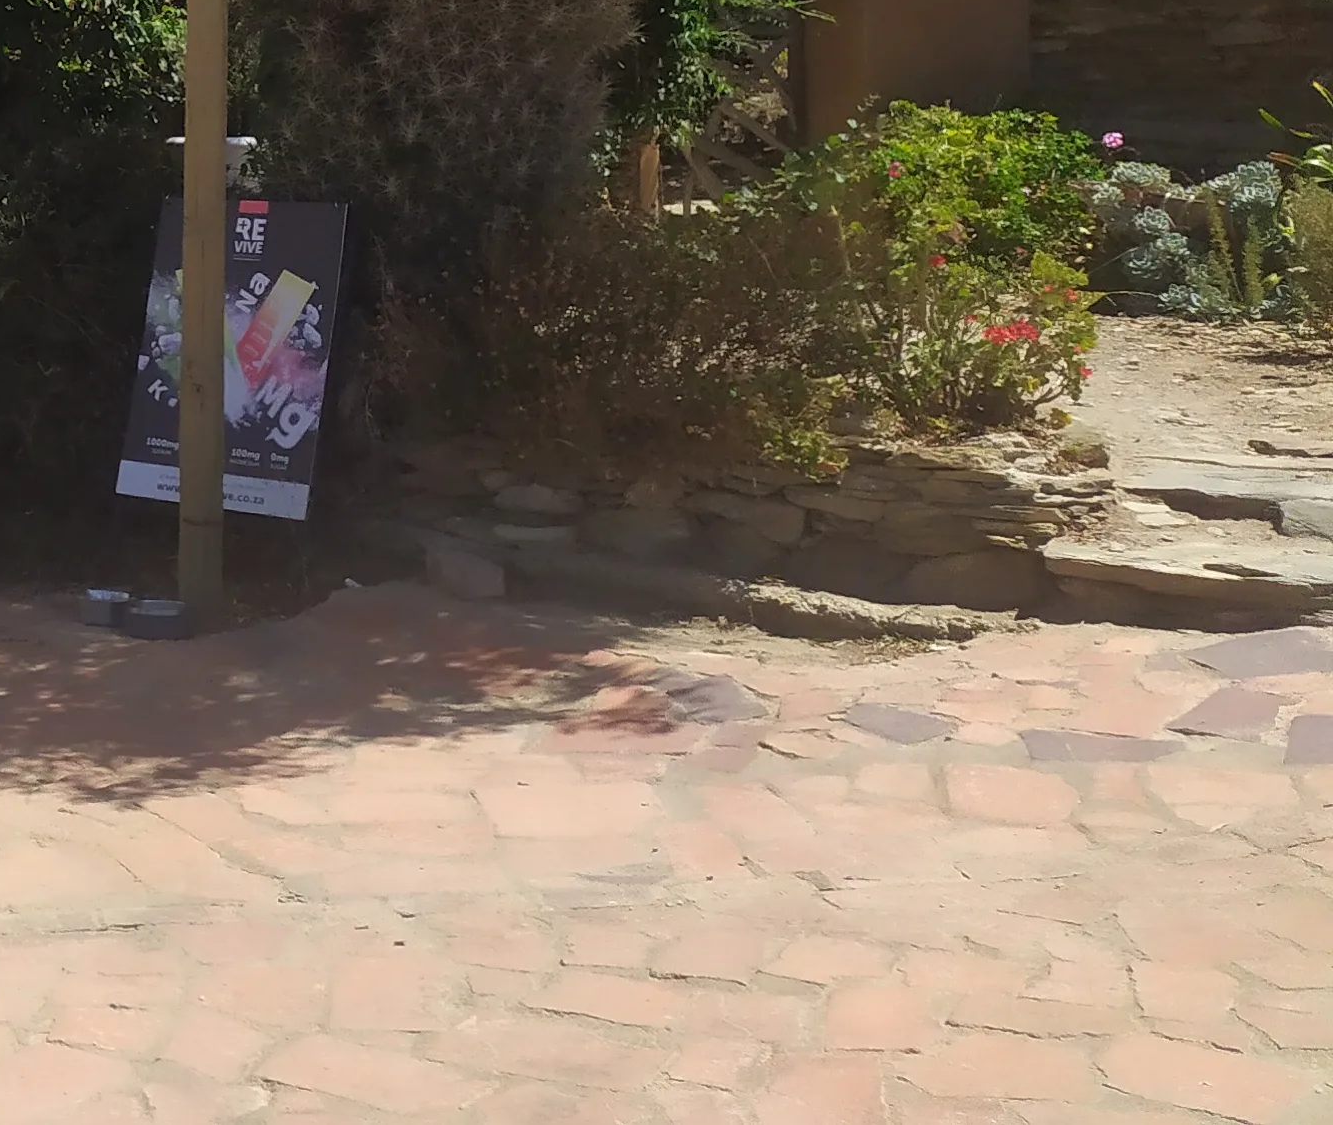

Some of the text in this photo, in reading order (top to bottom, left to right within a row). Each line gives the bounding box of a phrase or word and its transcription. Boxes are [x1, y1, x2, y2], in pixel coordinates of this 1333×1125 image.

[235, 217, 267, 241] RE
[234, 240, 264, 254] VIVE
[235, 272, 271, 314] Na
[255, 375, 317, 449] Mg
[231, 448, 260, 461] 100mg
[270, 452, 290, 465] 0mg
